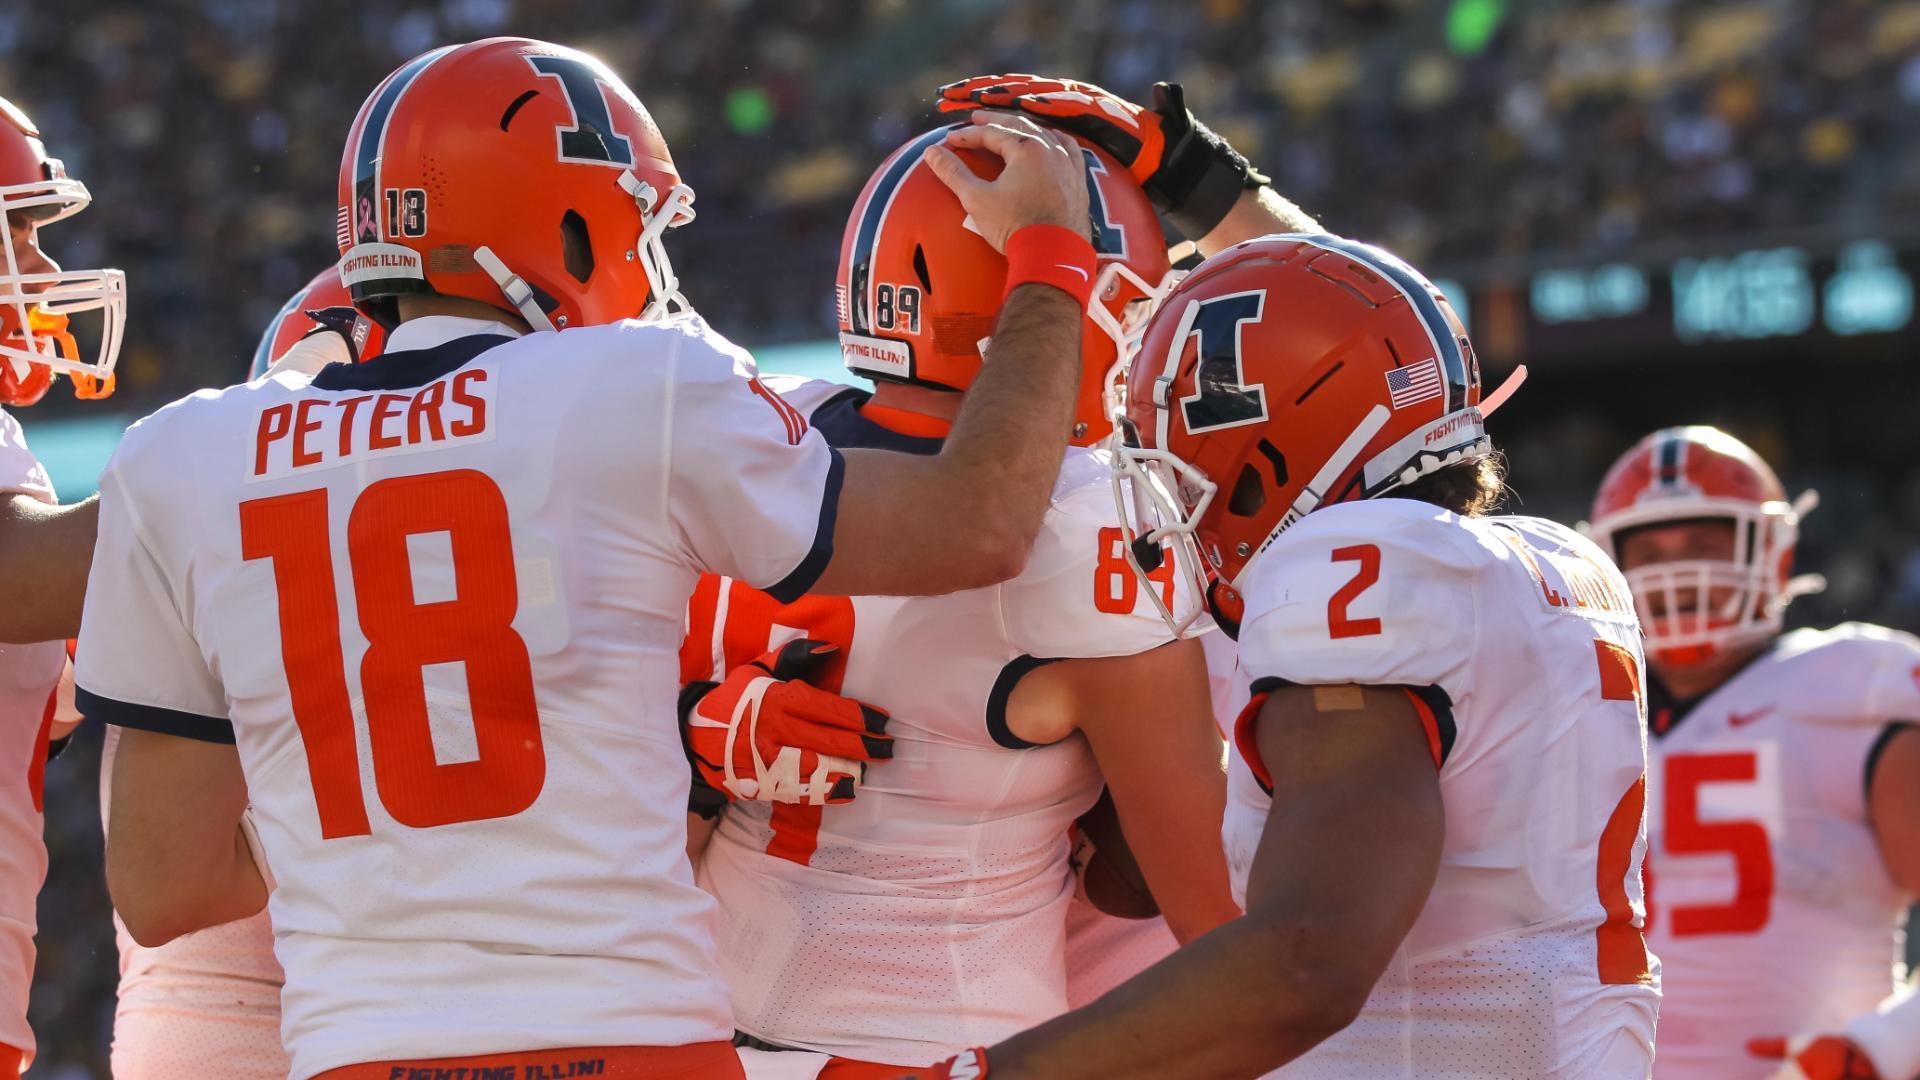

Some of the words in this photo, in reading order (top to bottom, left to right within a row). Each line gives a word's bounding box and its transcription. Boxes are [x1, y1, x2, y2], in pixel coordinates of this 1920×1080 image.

[385, 188, 427, 238] 18
[343, 255, 379, 276] FIGHTING
[380, 254, 417, 268] ILLINI
[876, 283, 921, 335] 89
[1179, 289, 1269, 435] I
[254, 369, 488, 476] PETERS
[1425, 413, 1470, 445] FIGHTING
[1327, 543, 1382, 640] 2
[239, 468, 547, 840] 18
[524, 1058, 606, 1080] ILLINI
